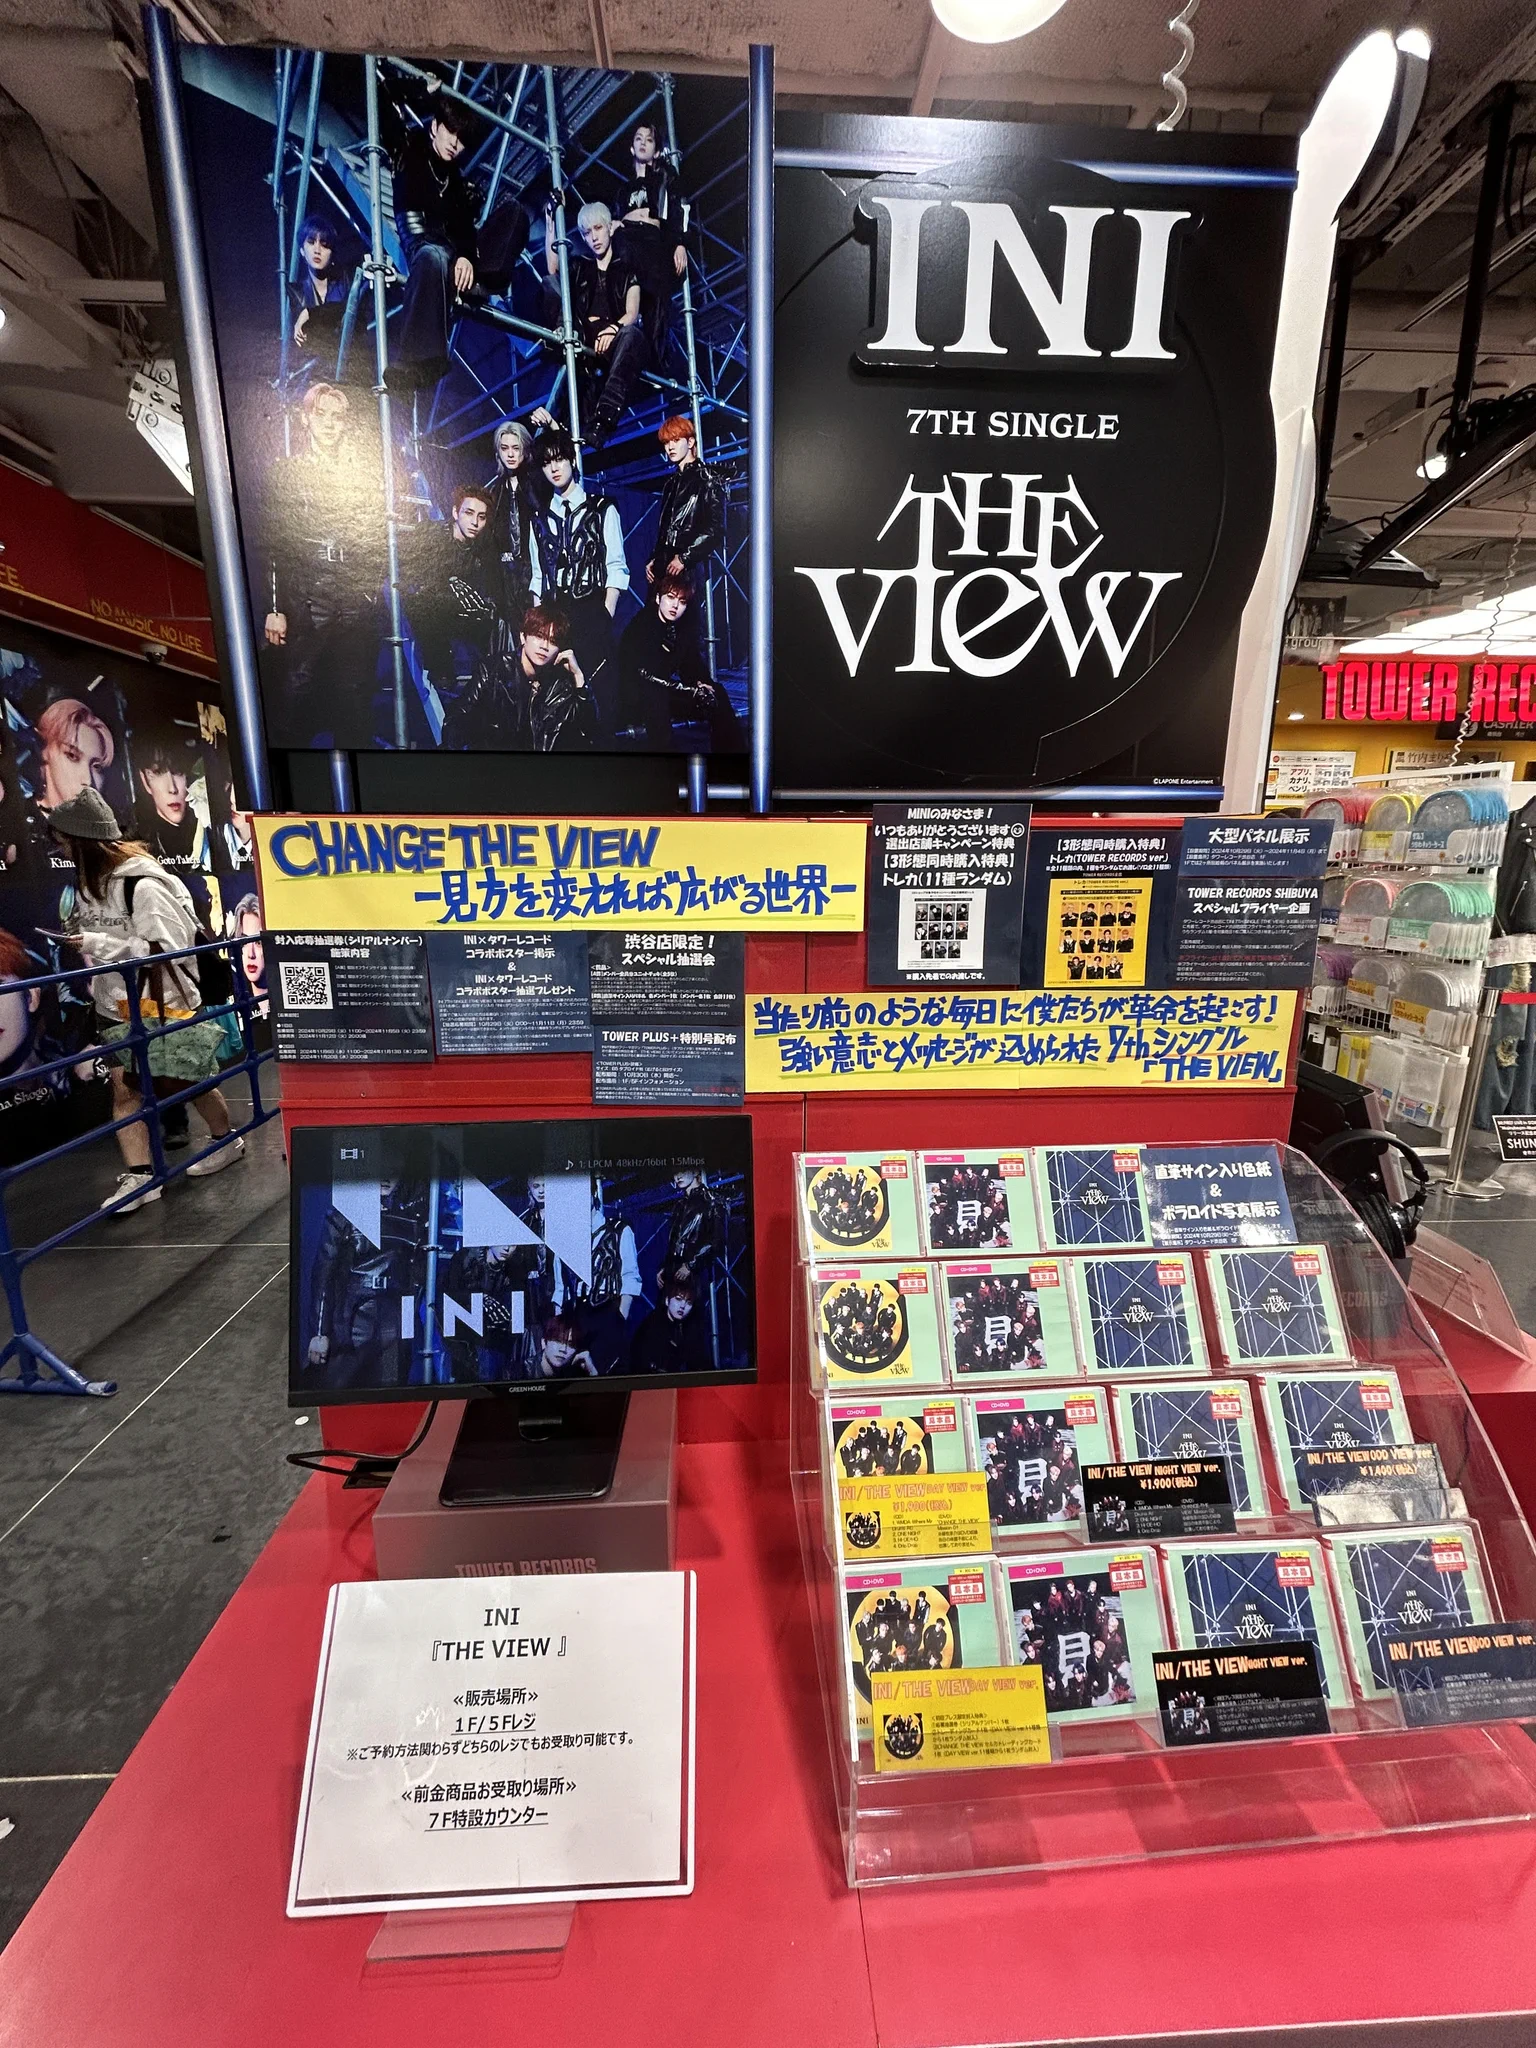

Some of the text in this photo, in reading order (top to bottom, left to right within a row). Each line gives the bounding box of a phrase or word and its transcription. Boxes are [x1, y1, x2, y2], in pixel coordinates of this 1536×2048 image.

[867, 197, 1192, 359] INI
[906, 409, 1120, 441] 7TH SINGLE
[877, 471, 1105, 571] THE
[1321, 661, 1458, 722] TOWER
[1208, 827, 1311, 845] 大型パネル展示
[270, 822, 660, 877] CHANGE THE VIEW
[1107, 853, 1147, 863] RECORDS
[1187, 887, 1319, 899] TOWER RECORDS SHIBUYA
[1192, 903, 1311, 915] スペシャルフライヤー企画
[463, 934, 552, 945] INI×タワーレコード
[624, 933, 716, 951] 渋谷店限定！
[465, 947, 556, 959] コラボポスター掲示
[621, 952, 716, 967] スペシャル抽選会
[507, 961, 517, 972] &
[475, 974, 553, 984] INI×タワーレコード
[601, 1031, 640, 1042] TOWER
[1154, 1161, 1273, 1180] 直筆サイン入り色紙
[1209, 1183, 1223, 1198] &
[1161, 1201, 1281, 1221] ポラロイド写真展示
[401, 1290, 525, 1340] INI
[1307, 1451, 1346, 1466] INI/THE
[1087, 1465, 1128, 1480] INI/THE
[1128, 1463, 1153, 1477] VIEW
[1154, 1464, 1179, 1476] NIGHT
[1180, 1463, 1202, 1474] VIEW
[1405, 1589, 1417, 1597] INI
[1244, 1603, 1257, 1611] INI
[482, 1607, 521, 1628] INI
[491, 1637, 551, 1659] VIEW
[346, 1731, 635, 1762] ※ご予約方法関わらずどちらのレジでもお受取り可能です。
